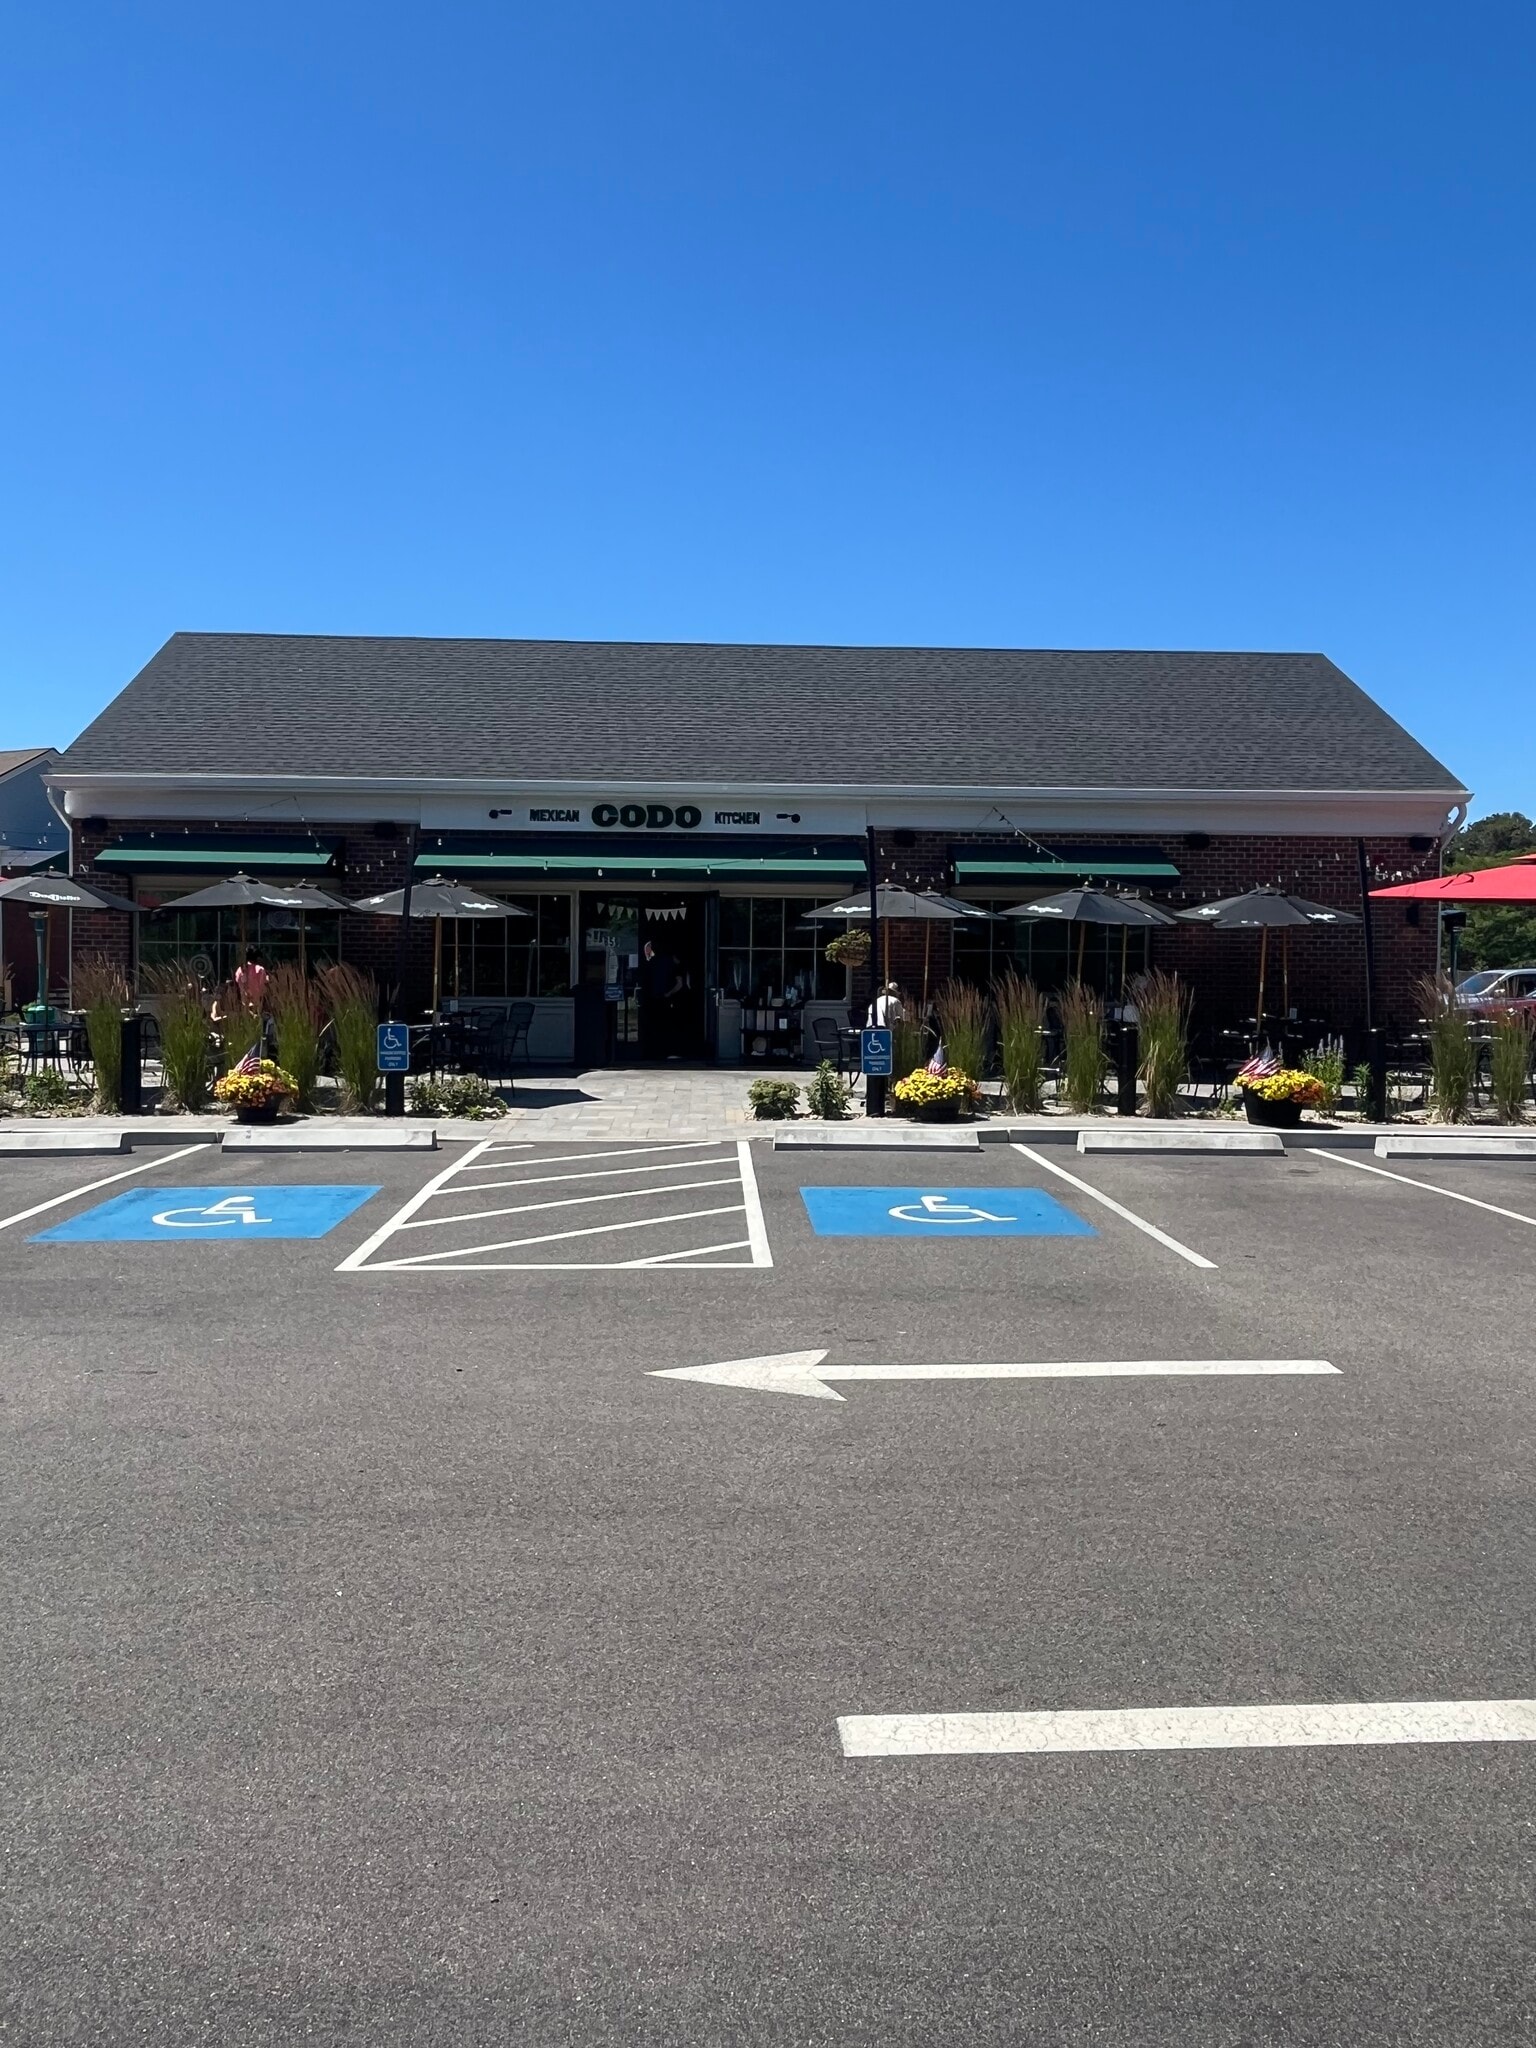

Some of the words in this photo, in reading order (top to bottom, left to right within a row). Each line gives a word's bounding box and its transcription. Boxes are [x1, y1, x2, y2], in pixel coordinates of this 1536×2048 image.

[529, 809, 580, 822] MEXICAN
[591, 804, 702, 828] CODO
[714, 811, 761, 825] KITCHEN
